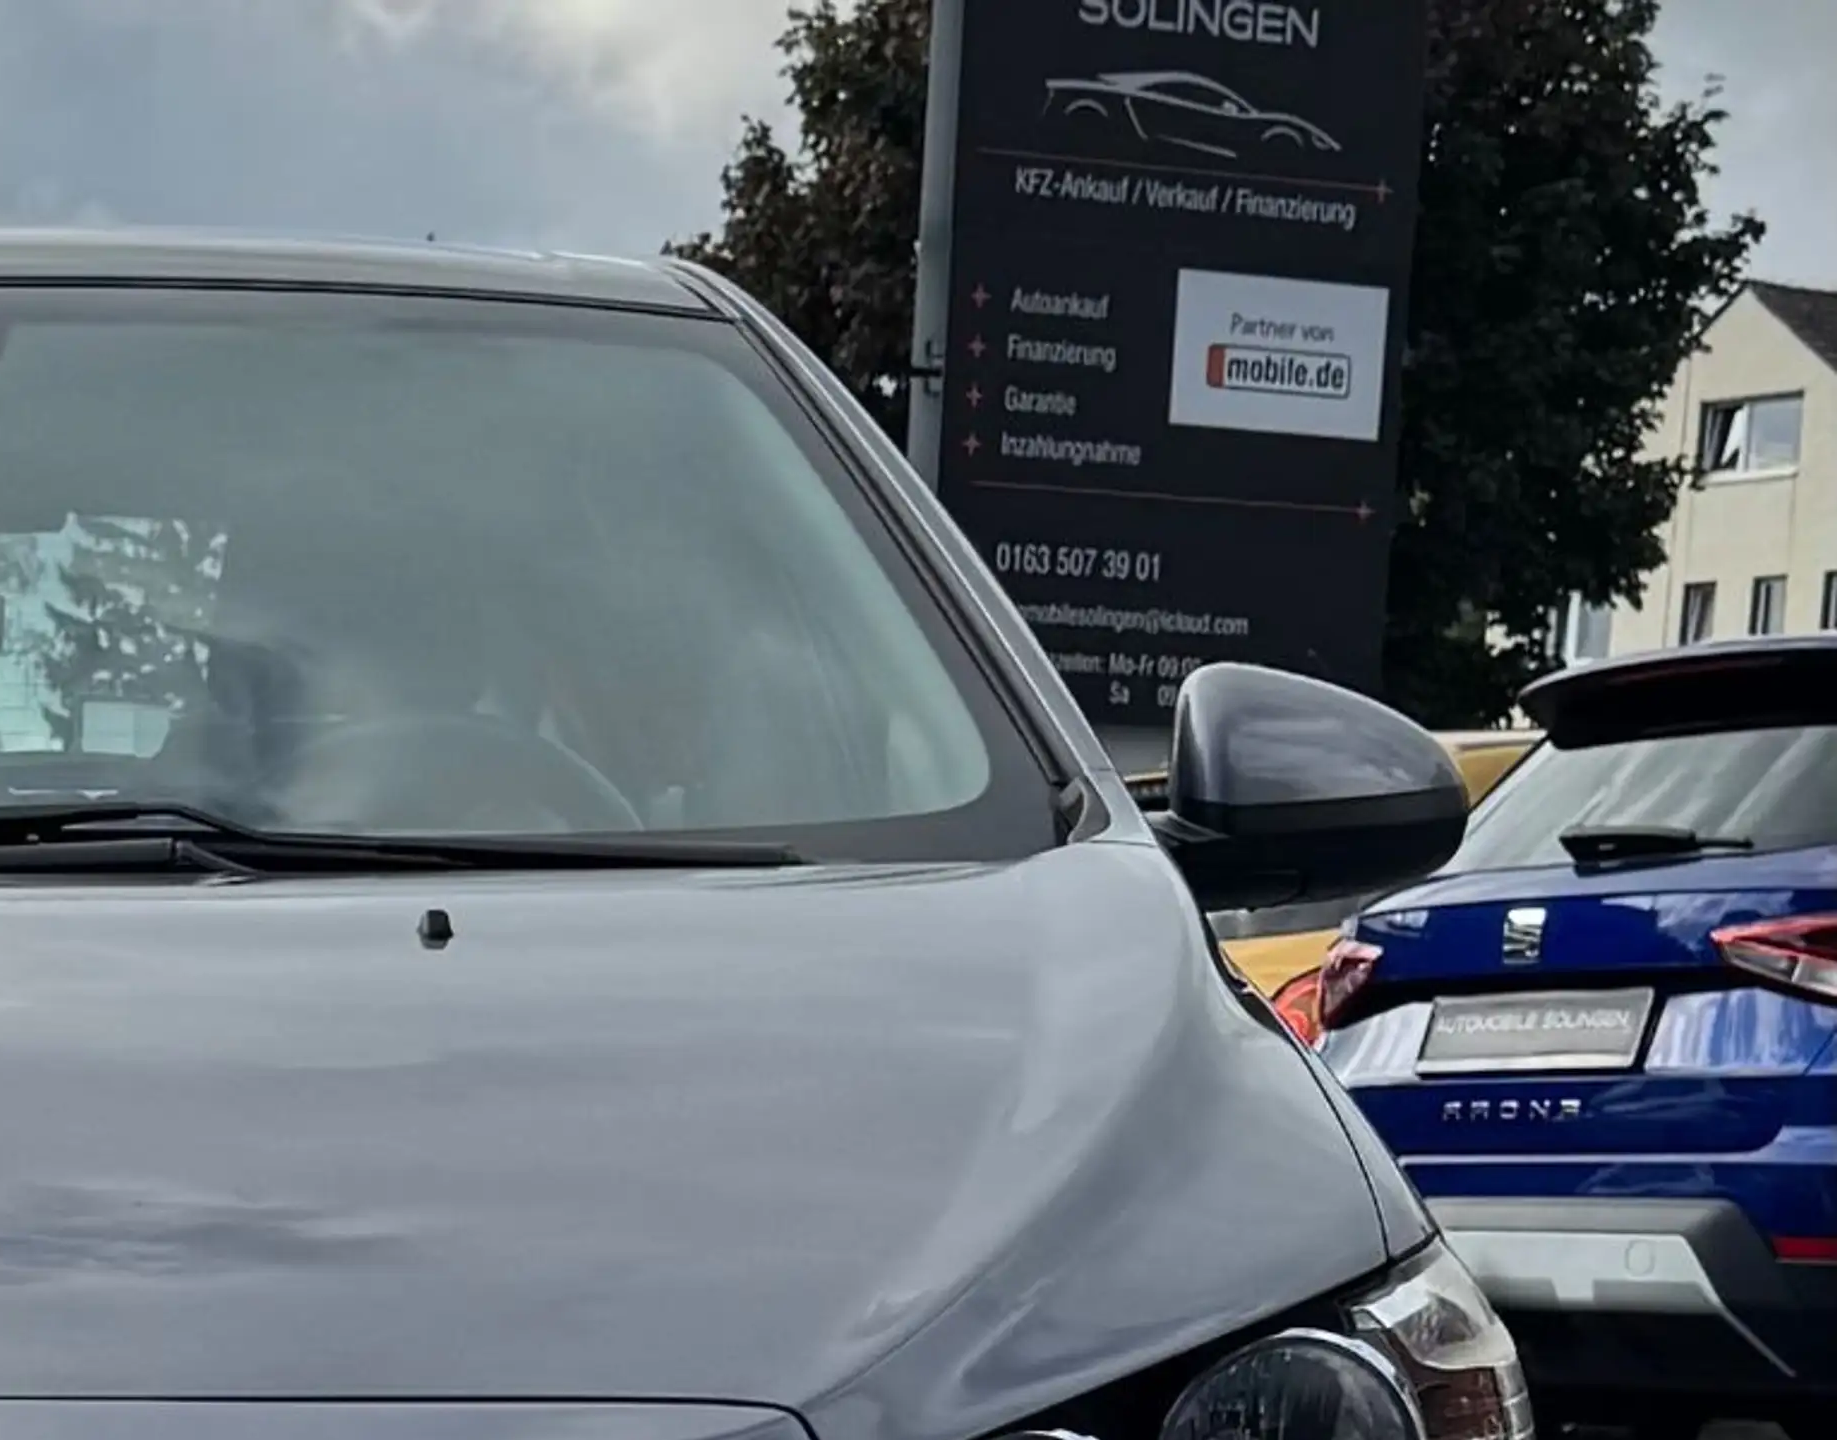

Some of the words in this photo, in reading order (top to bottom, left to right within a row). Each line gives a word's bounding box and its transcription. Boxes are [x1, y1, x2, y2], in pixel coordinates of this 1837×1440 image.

[1077, 0, 1319, 47] SOLINGEN
[1015, 167, 1128, 203] KFZ-Ankauf
[1145, 180, 1220, 212] Verkauf
[1235, 187, 1356, 231] Finanzierung
[1010, 287, 1109, 319] Autoankauf
[1229, 311, 1297, 342] Partner
[1300, 323, 1336, 344] von
[1007, 334, 1116, 372] Finanzierung
[1227, 353, 1345, 389] mobile.de
[1004, 387, 1077, 416] Garantie
[1001, 432, 1141, 467] Inzahlungnahme
[997, 541, 1050, 575] 0163
[1055, 546, 1097, 577] 507
[1102, 549, 1131, 580] 39
[1135, 551, 1161, 582] 01
[1108, 652, 1156, 676] Mo-Fr
[1108, 680, 1131, 704] Sa
